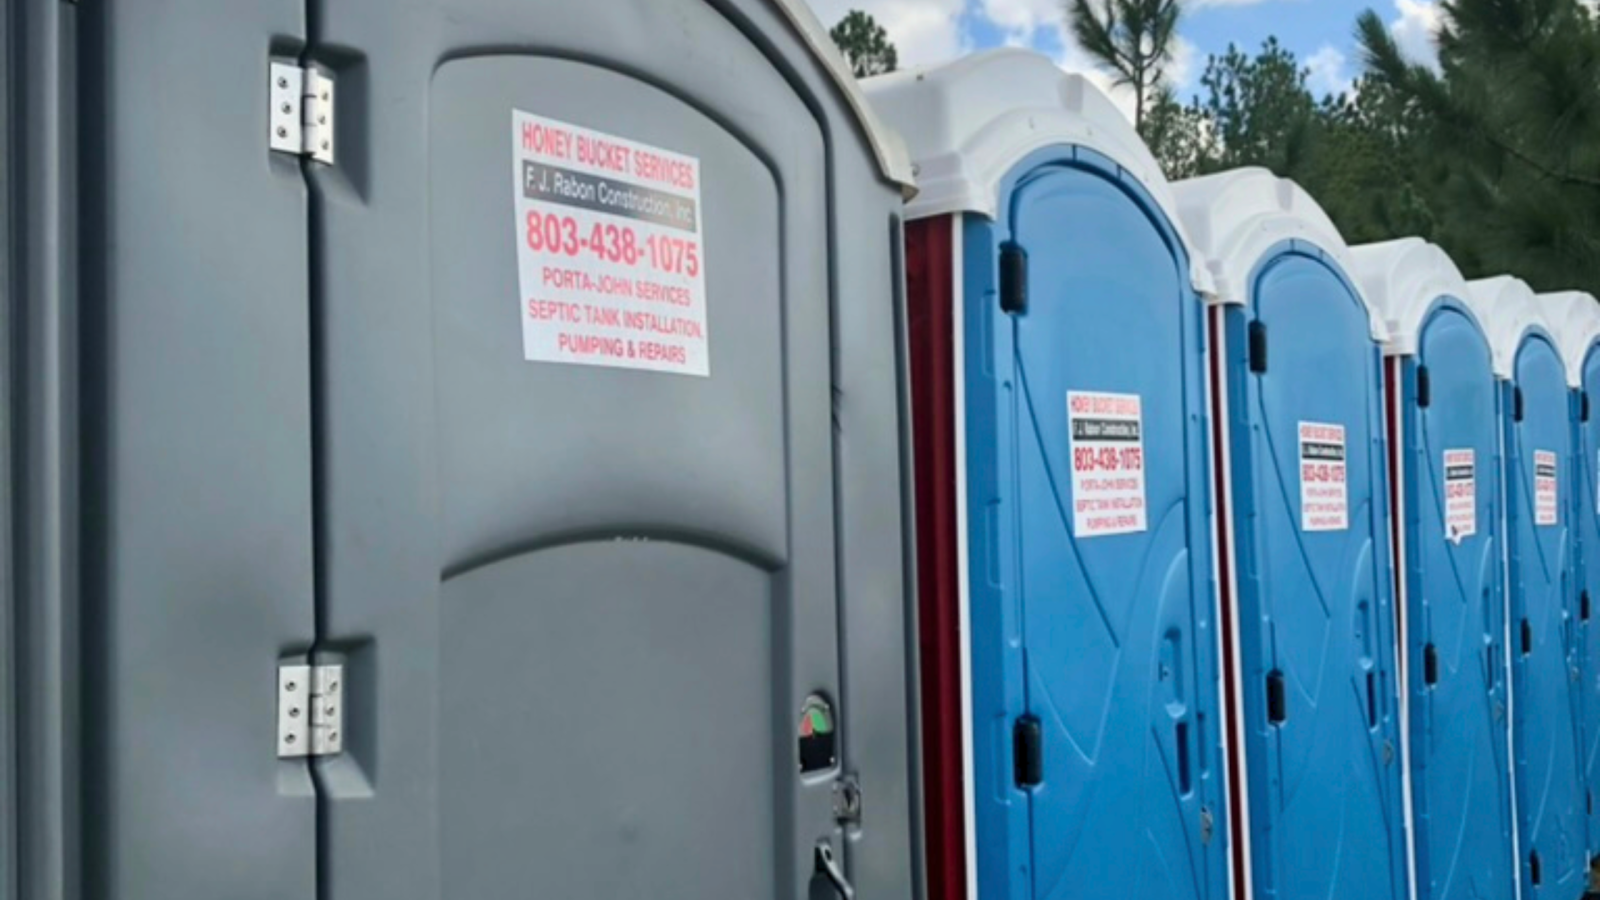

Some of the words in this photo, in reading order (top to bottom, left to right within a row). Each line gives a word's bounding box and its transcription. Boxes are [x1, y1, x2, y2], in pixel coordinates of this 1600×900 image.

[522, 121, 573, 160] HONEY
[577, 135, 631, 173] BUCKET
[634, 150, 694, 189] SERVICES
[553, 173, 596, 199] Rabon
[526, 209, 699, 278] 803-438-1075
[542, 266, 633, 297] PORTA-JOHN
[635, 280, 691, 307] SERVICES
[528, 298, 581, 324] SEPTIC
[584, 304, 621, 327] TANK
[558, 333, 624, 358] PUMPING
[627, 340, 636, 359] &
[638, 341, 686, 364] REPAIRS
